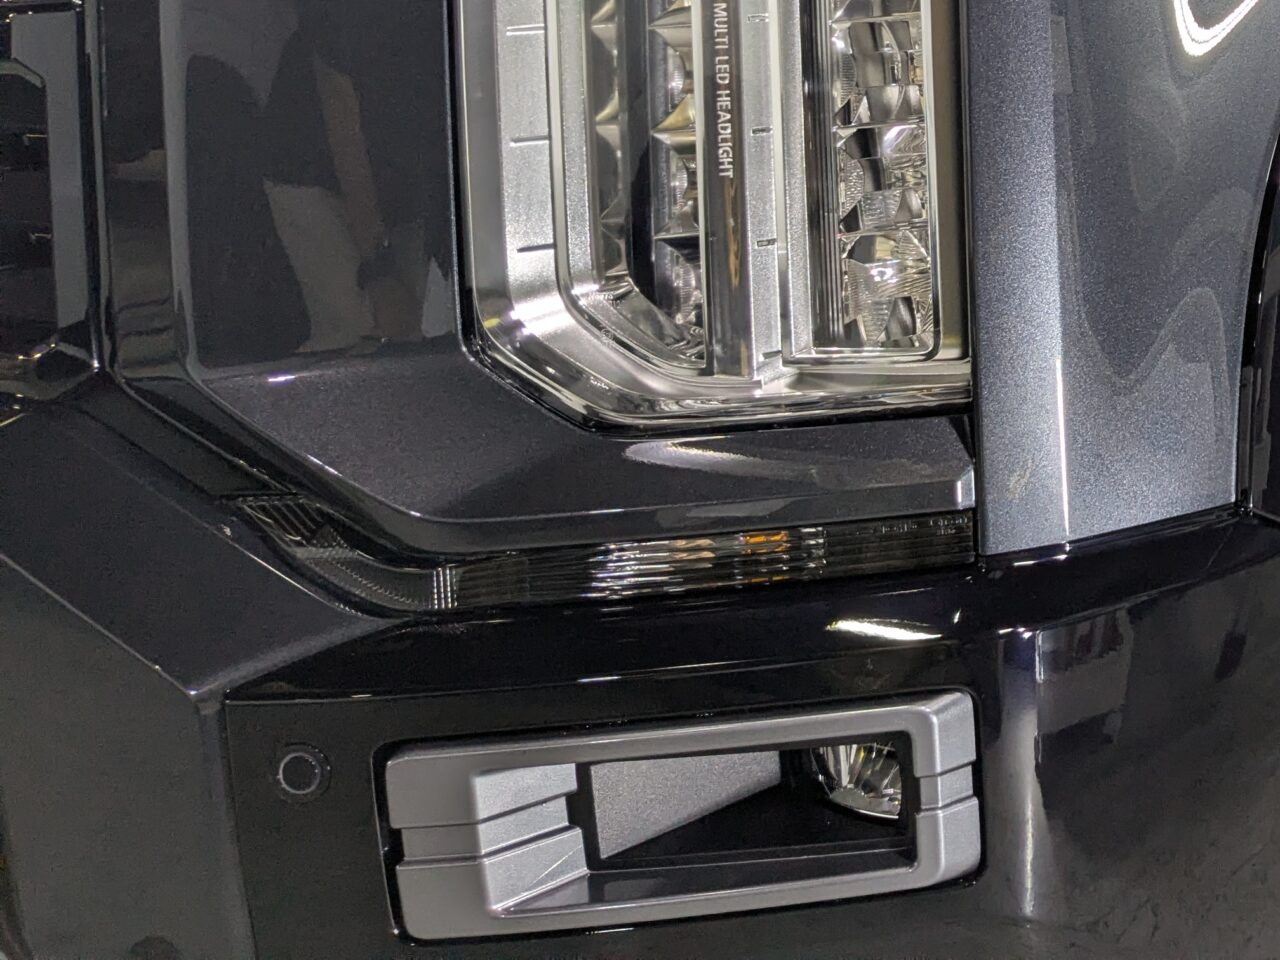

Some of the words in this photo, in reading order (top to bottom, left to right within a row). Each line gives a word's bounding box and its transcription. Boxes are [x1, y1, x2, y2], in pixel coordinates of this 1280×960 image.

[713, 3, 728, 49] MULTI
[716, 56, 730, 84] LED
[716, 90, 733, 178] HEADLIGHT
